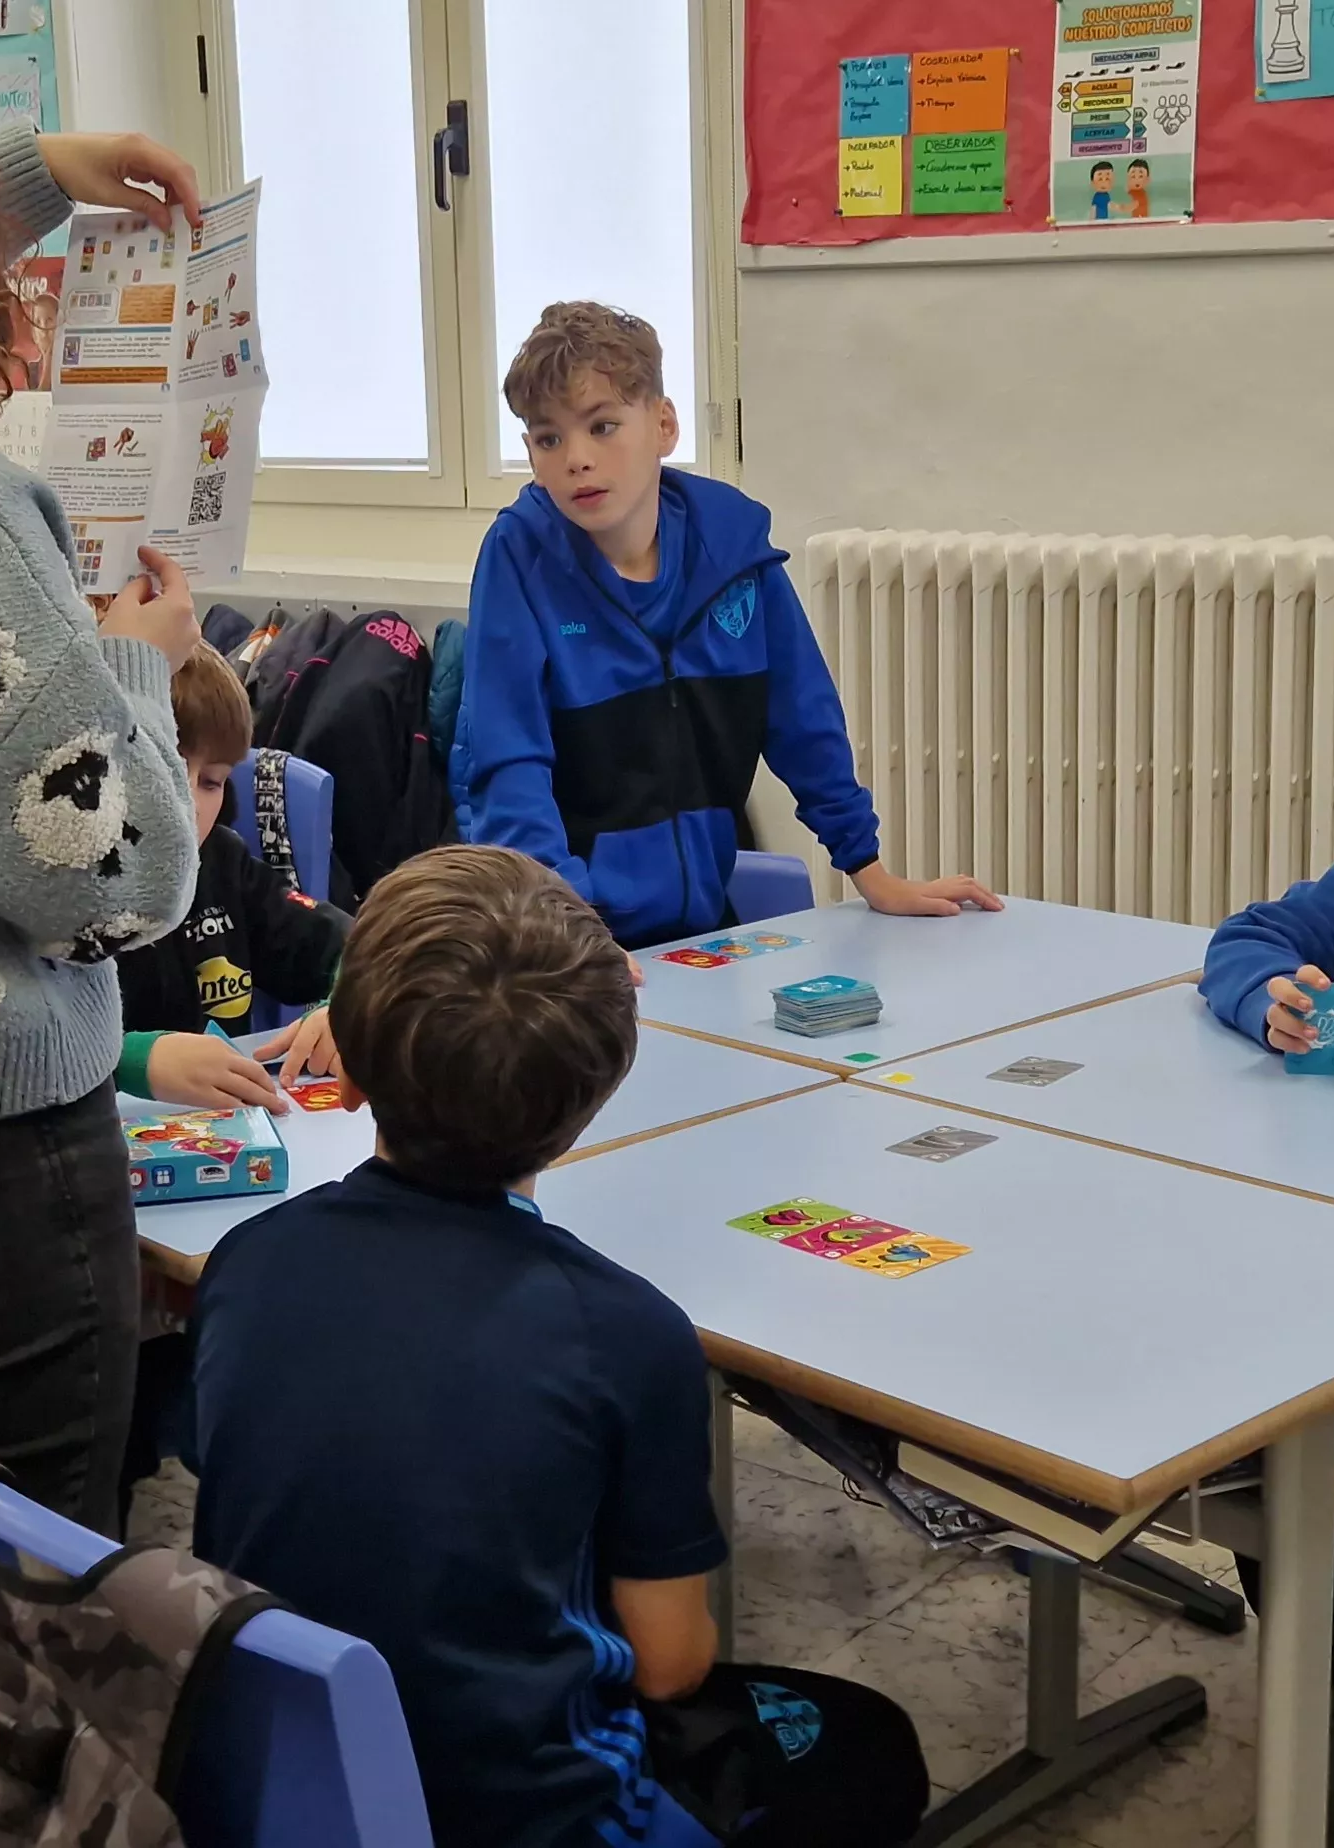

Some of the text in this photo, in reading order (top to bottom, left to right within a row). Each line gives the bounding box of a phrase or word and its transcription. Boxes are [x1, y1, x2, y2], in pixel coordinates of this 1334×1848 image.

[1082, 1, 1173, 24] SOLUCIONAMOS
[1064, 15, 1193, 42] NUESTROS CONFLICTOS
[919, 53, 984, 67] COORDINADOR
[924, 136, 996, 151] OBSERVADOR
[365, 621, 418, 660] adidas
